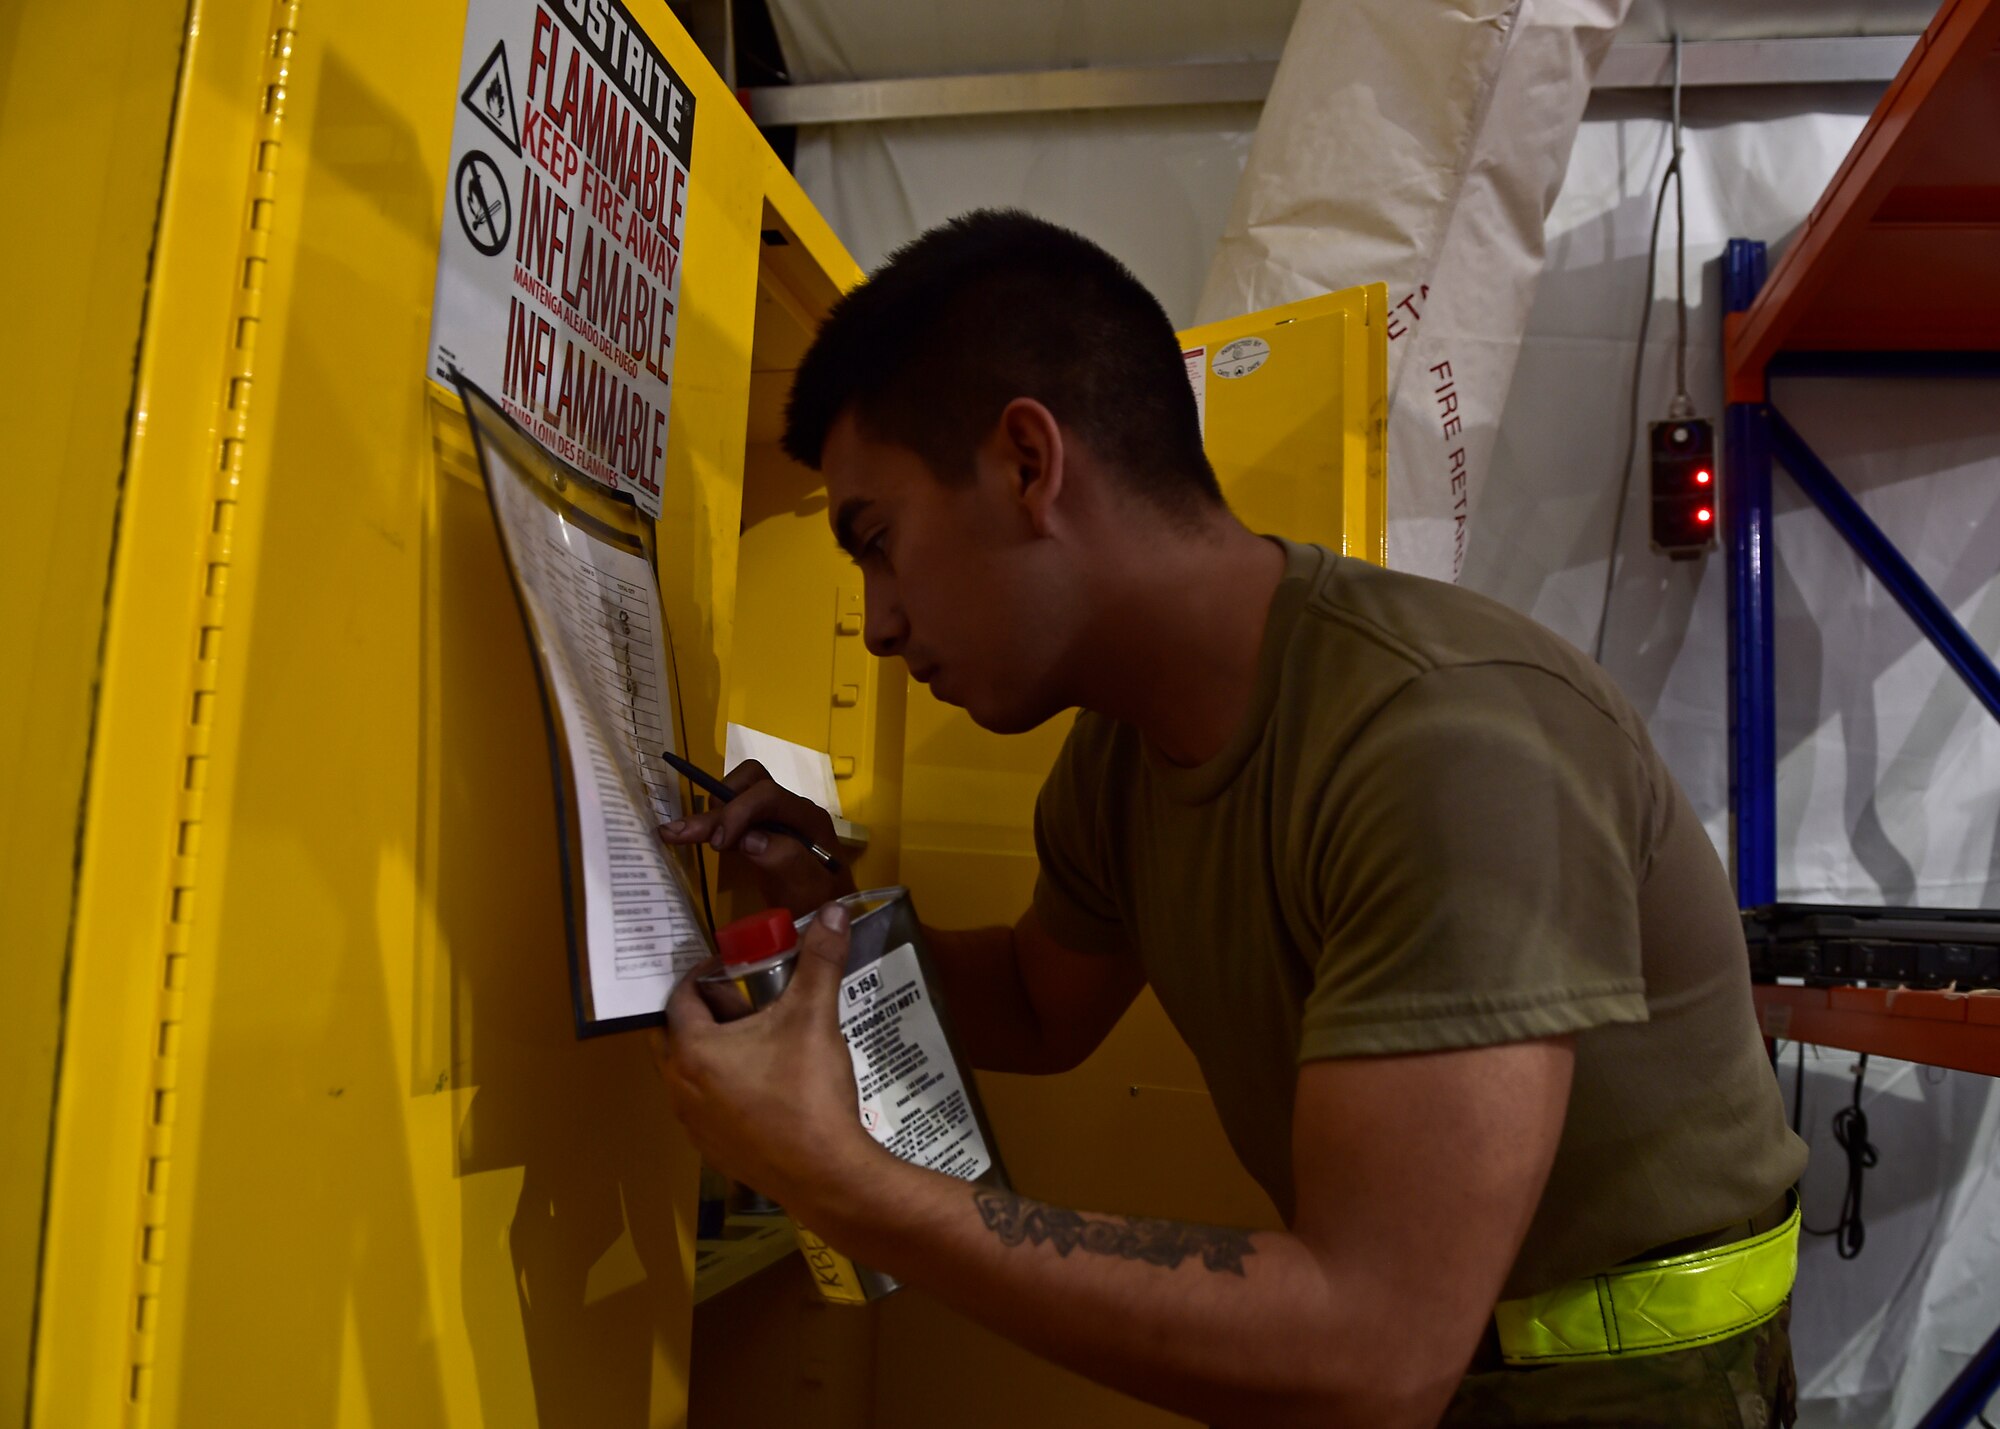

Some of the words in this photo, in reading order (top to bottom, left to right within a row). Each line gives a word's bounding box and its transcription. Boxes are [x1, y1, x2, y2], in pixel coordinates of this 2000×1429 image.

[522, 100, 578, 189] KEEP
[580, 161, 625, 242] FIRE
[625, 211, 678, 291] AWAY
[527, 4, 685, 253] FLAMMABLE
[513, 264, 563, 320] MANTENGA
[564, 307, 599, 347] ALEJADO
[599, 335, 614, 360] DEL
[614, 348, 639, 379] FUEGO
[516, 165, 674, 385] INFLAMABLE
[503, 295, 666, 497] INFLAMMABLE
[534, 419, 556, 449] LOIN
[558, 435, 576, 461] DES
[576, 449, 619, 489] FLAMMES
[1430, 361, 1462, 441] FIRE
